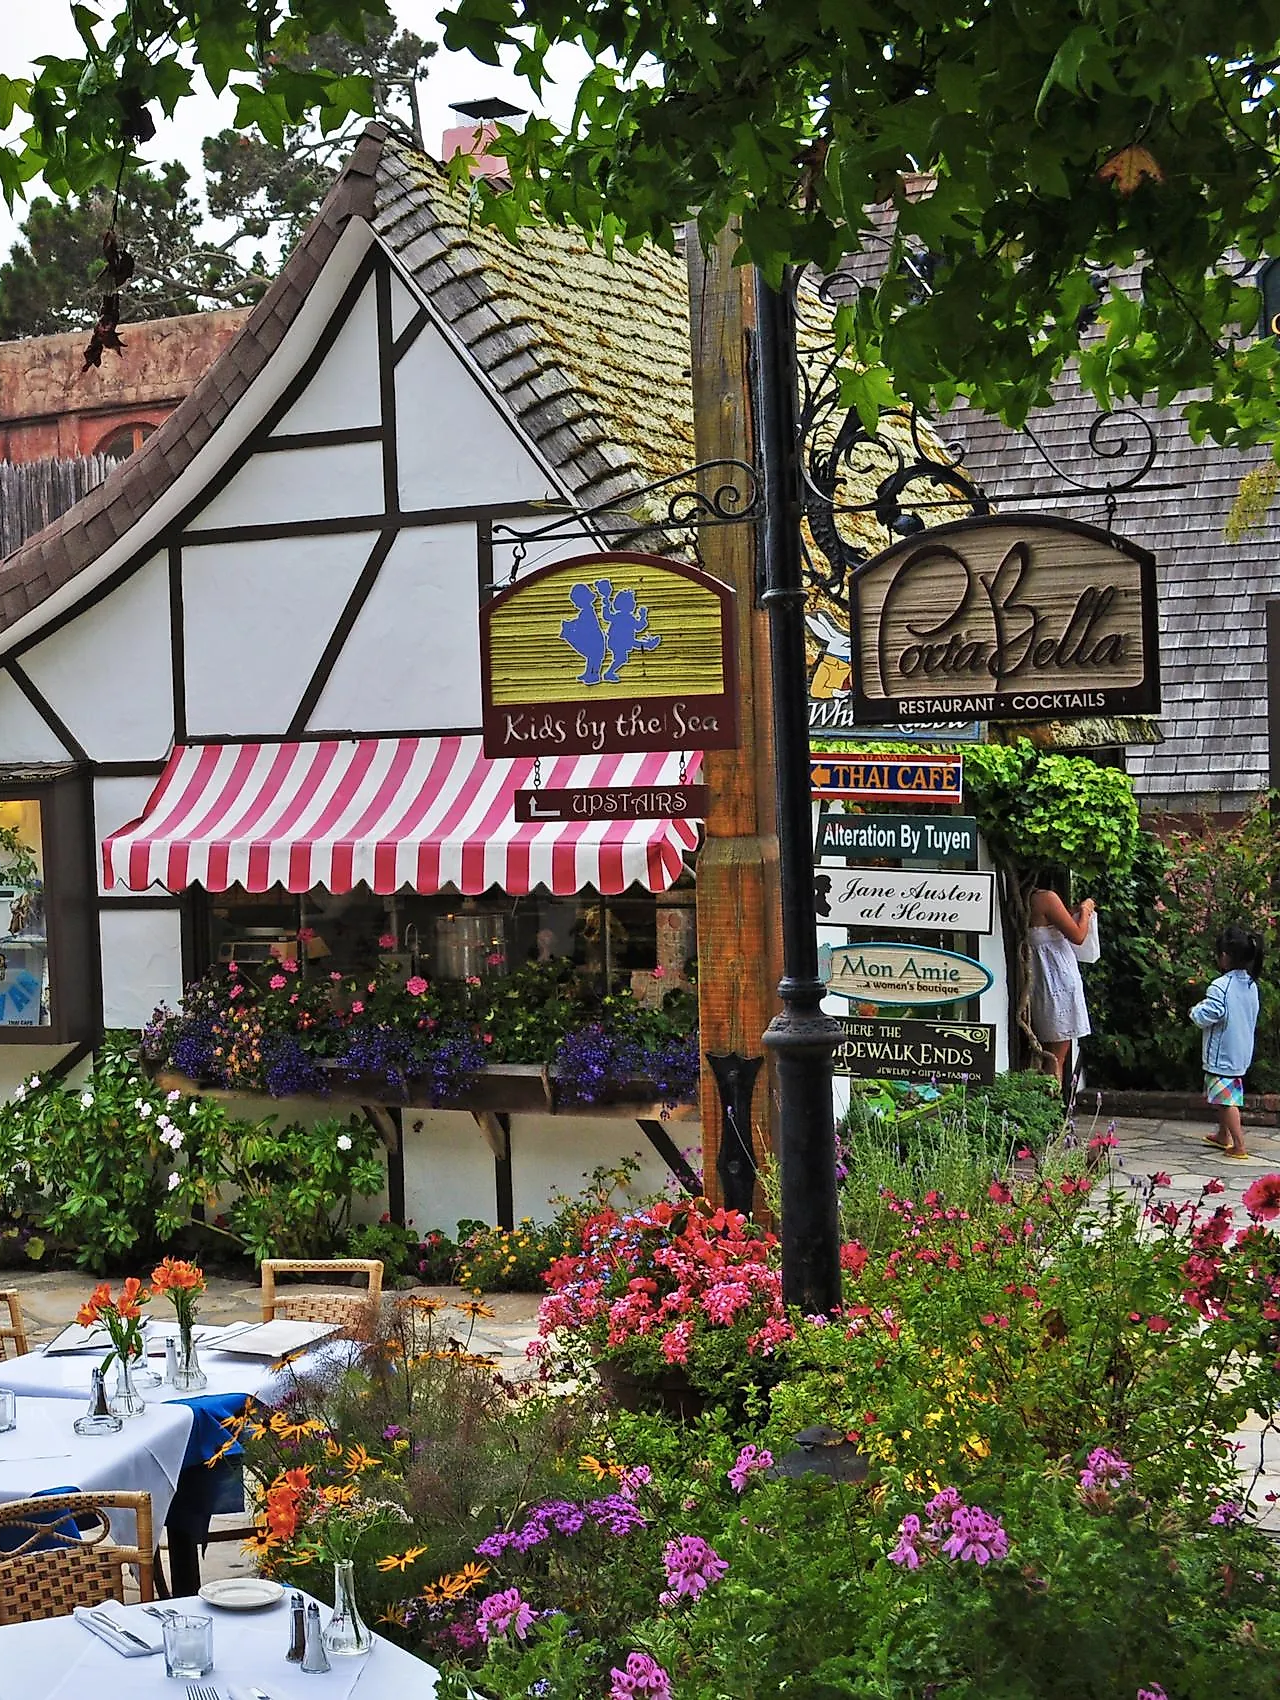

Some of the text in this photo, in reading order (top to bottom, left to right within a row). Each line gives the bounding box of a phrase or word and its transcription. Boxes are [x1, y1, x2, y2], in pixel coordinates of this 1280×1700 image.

[898, 692, 1105, 715] RESTAURANT COCKTAILS
[504, 702, 720, 750] Kids by the Sea
[833, 765, 957, 790] THAI CAFE
[573, 791, 688, 814] UPSTAIRS
[823, 822, 971, 855] Alteration By Tuyen
[838, 877, 983, 903] Jane Austen
[860, 901, 960, 923] at Home
[840, 954, 961, 982] Mon Amie
[873, 981, 915, 991] women's
[917, 981, 960, 995] boutique
[879, 1025, 902, 1039] THE
[832, 1041, 974, 1067] IDEWALK ENDS
[876, 1067, 981, 1081] JEWELRY GIFTS FASON
